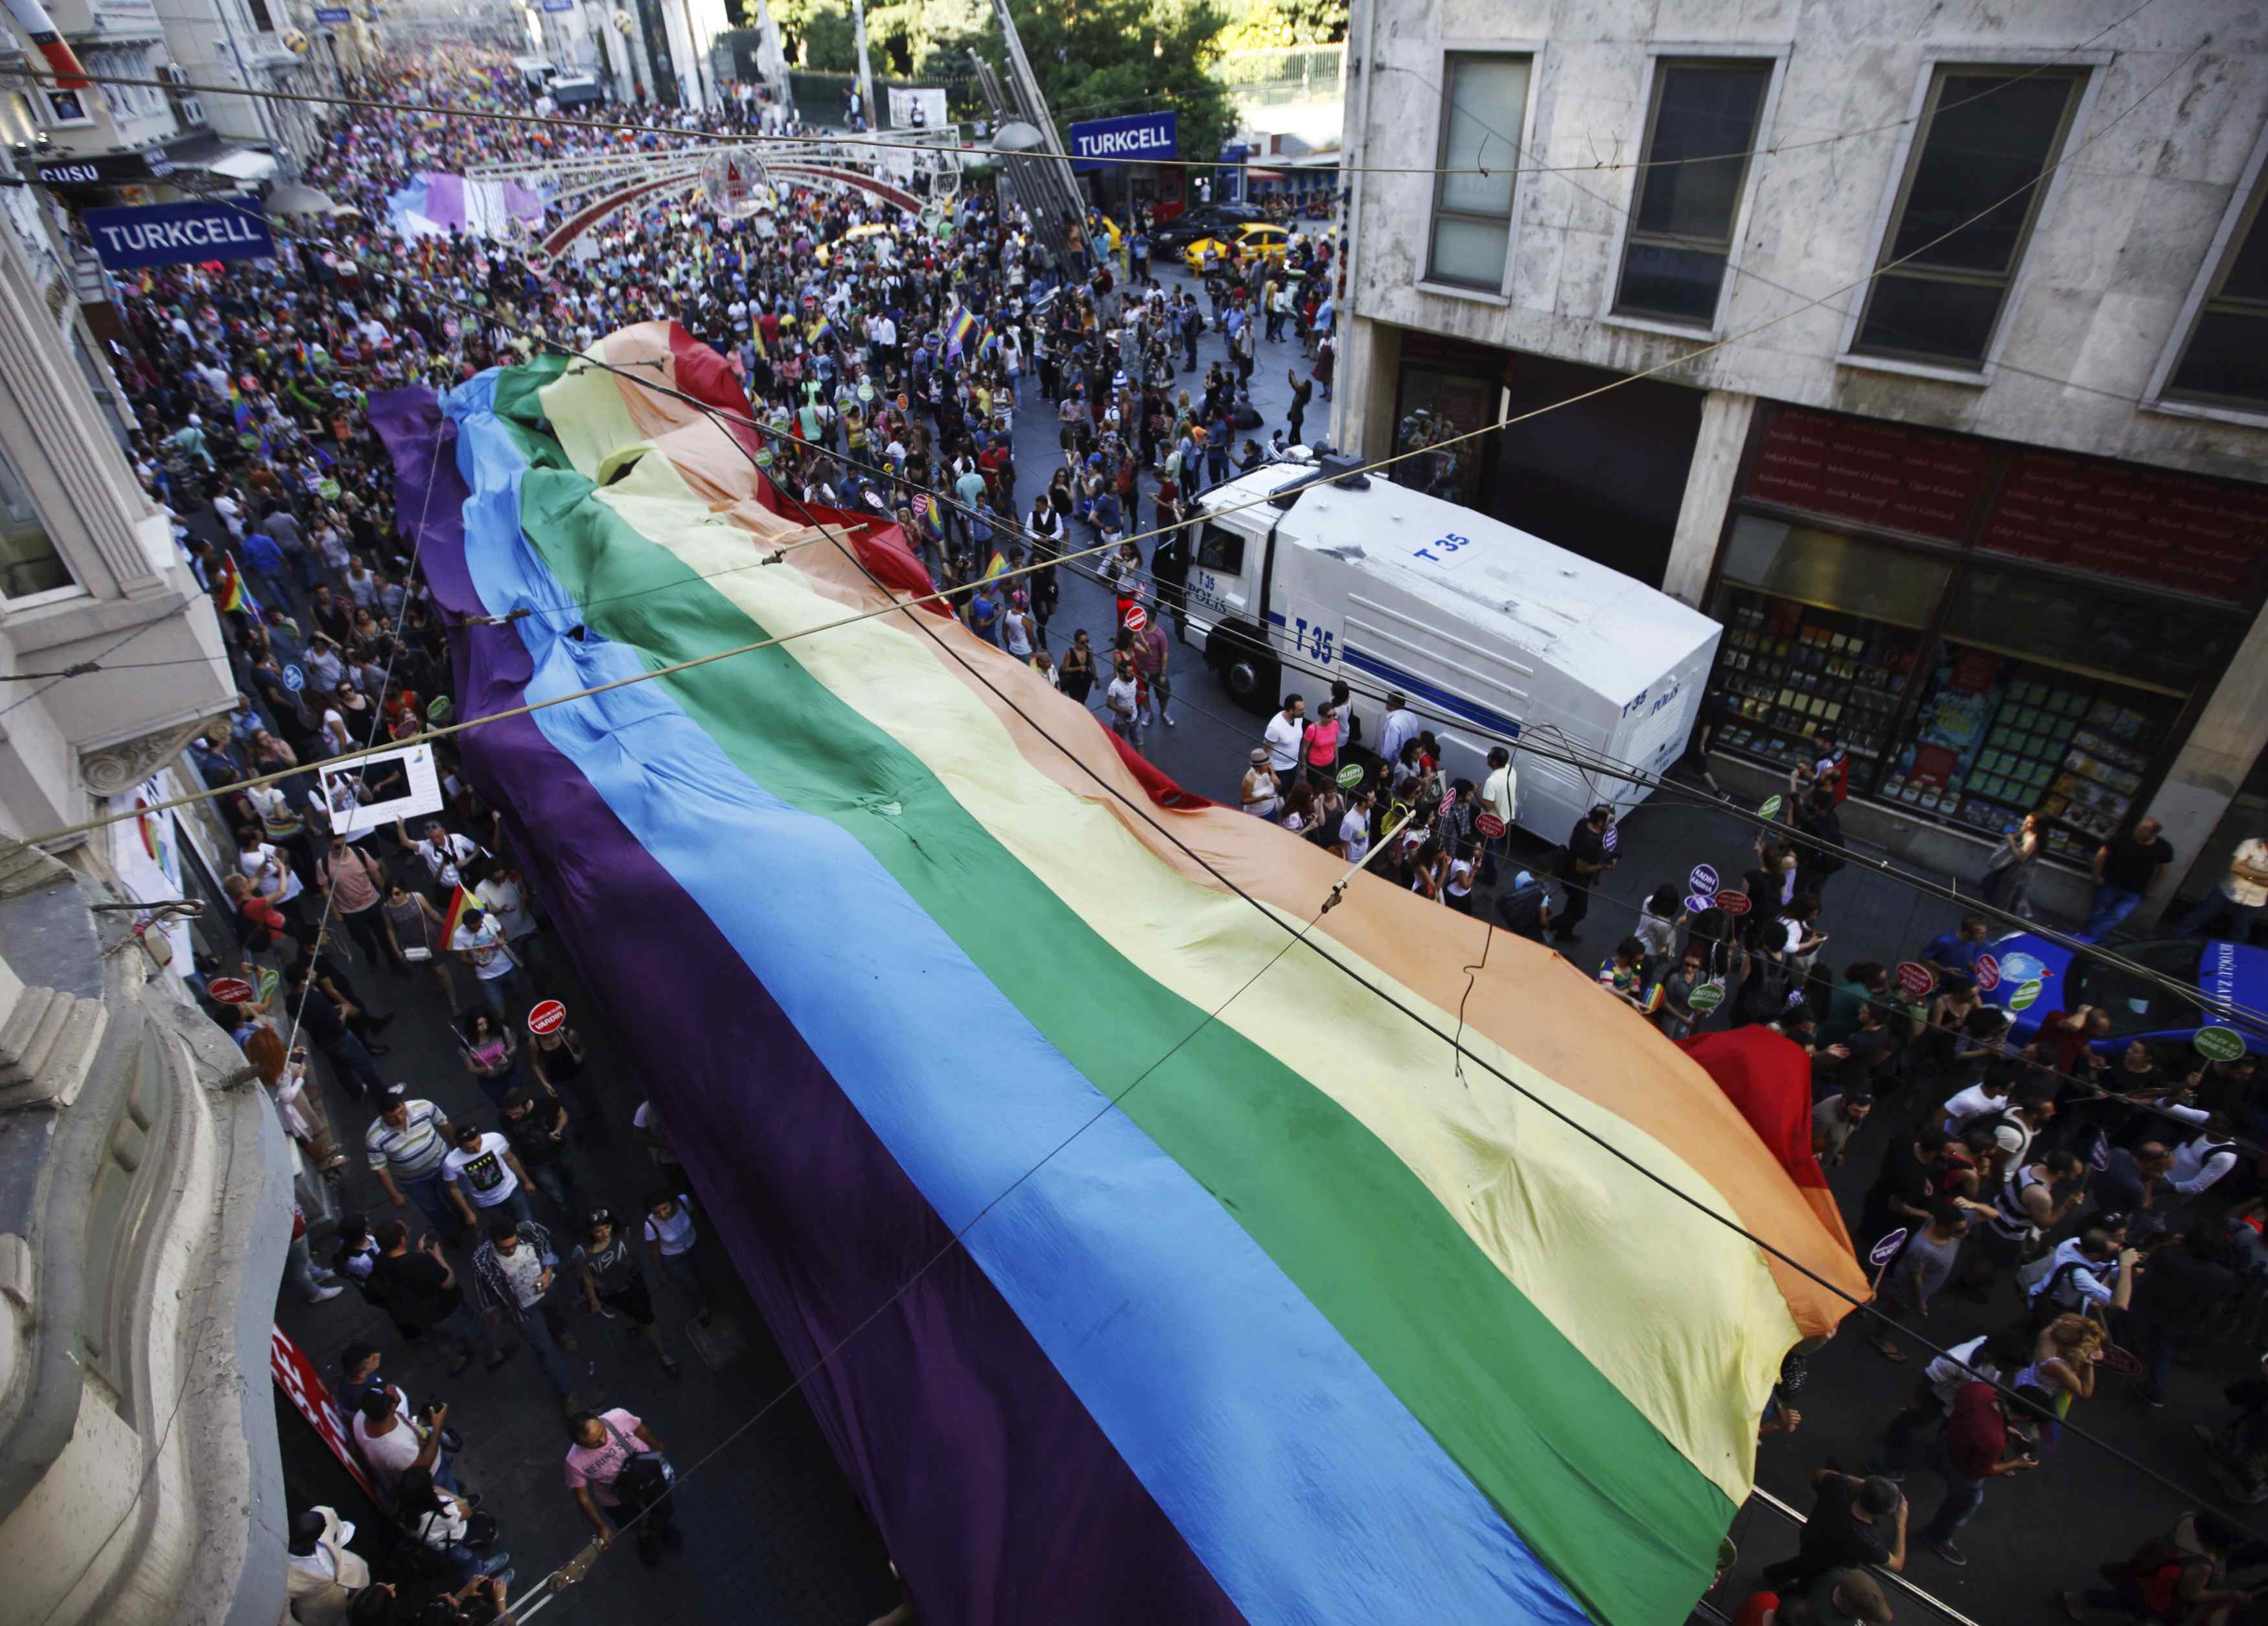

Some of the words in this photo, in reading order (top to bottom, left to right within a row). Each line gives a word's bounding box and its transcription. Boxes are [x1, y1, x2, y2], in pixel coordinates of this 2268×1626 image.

[1078, 126, 1171, 156] TURKCELL
[100, 216, 262, 252] TURKCELL
[1413, 548, 1439, 561] T
[1435, 533, 1470, 552] 35
[1199, 570, 1204, 585] T
[1205, 575, 1215, 591] 35
[1296, 616, 1308, 651] T
[1311, 626, 1334, 664] 35
[1623, 701, 1632, 719] T
[1632, 689, 1648, 710] 35
[1694, 868, 1717, 886] KADIN
[468, 1156, 491, 1172] PARTY
[616, 1431, 632, 1450] SA
